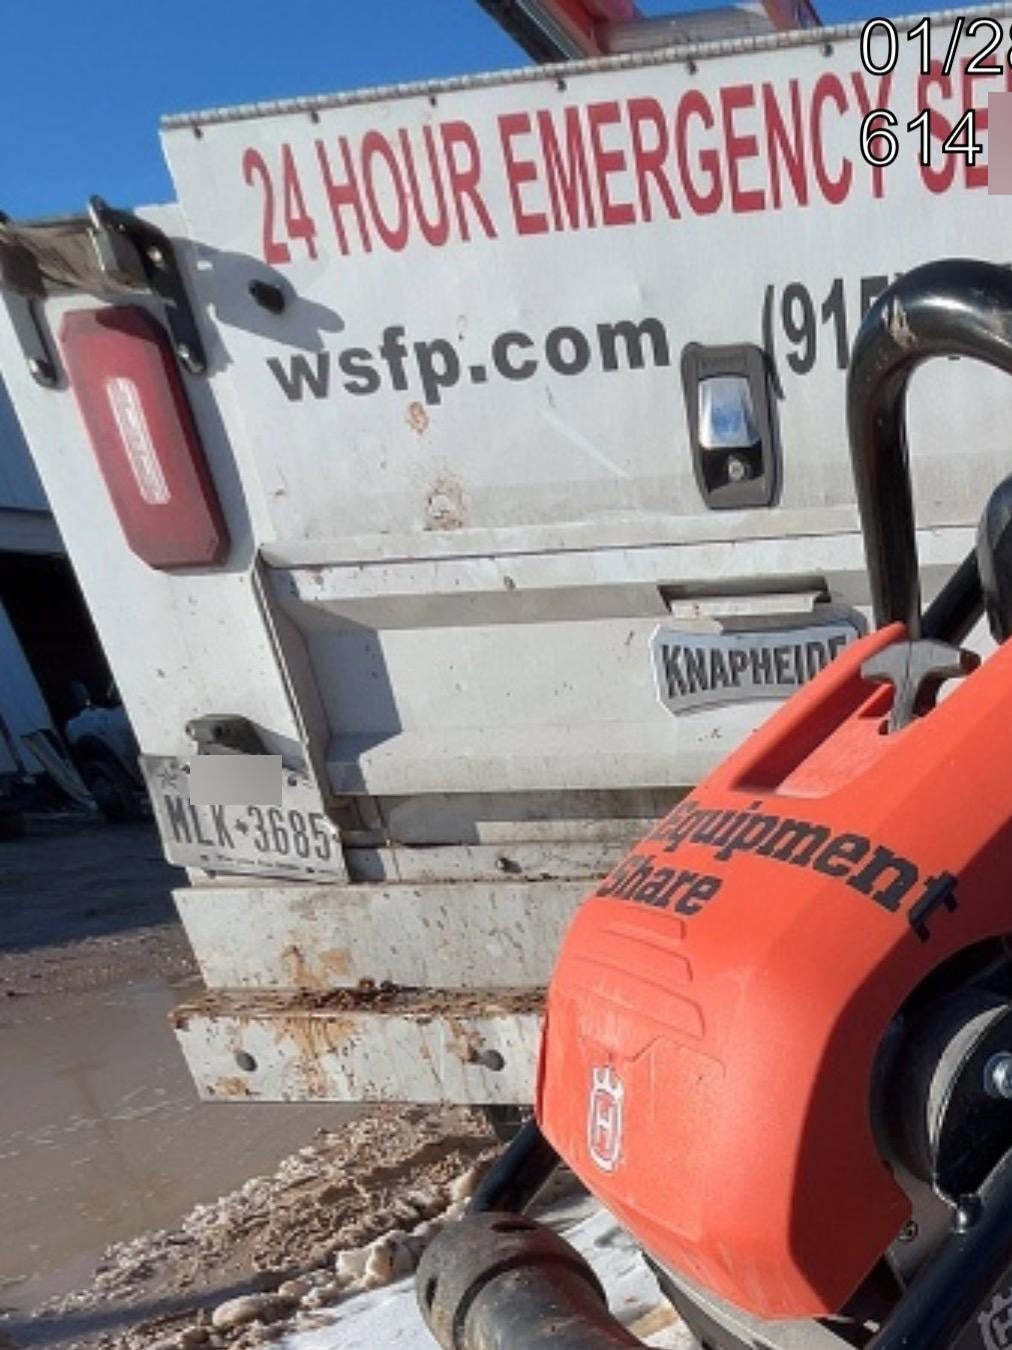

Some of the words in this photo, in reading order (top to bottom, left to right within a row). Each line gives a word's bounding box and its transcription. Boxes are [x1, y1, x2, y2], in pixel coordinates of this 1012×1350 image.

[243, 143, 318, 265] 24
[315, 118, 497, 257] HOUR
[498, 71, 891, 236] EMERGENCY
[267, 313, 671, 405] wsfp.com
[596, 854, 723, 916] Share
[648, 800, 960, 943] Equipment
